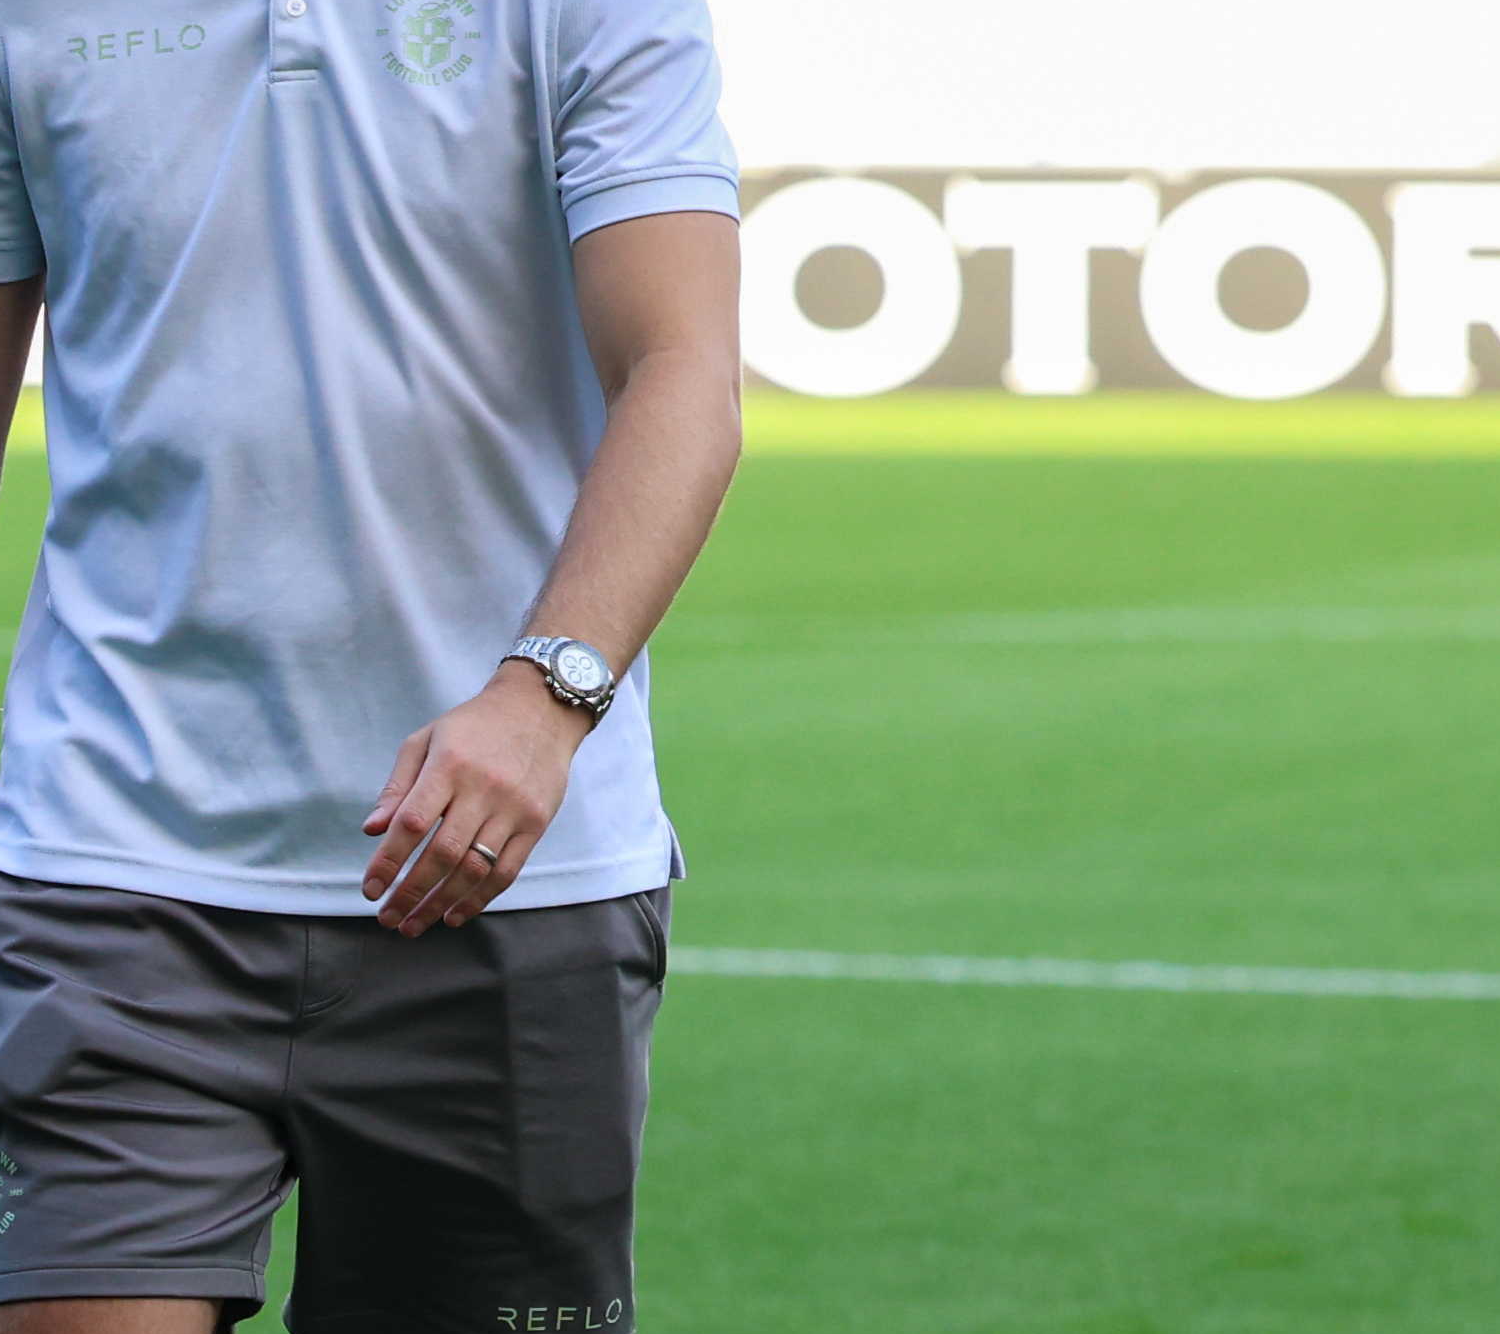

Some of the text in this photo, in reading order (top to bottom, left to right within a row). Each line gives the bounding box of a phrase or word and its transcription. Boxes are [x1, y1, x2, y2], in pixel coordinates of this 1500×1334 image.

[67, 23, 206, 62] REFLO
[382, 51, 473, 86] FOOTBALL CLUB
[497, 1298, 622, 1331] REFLO
